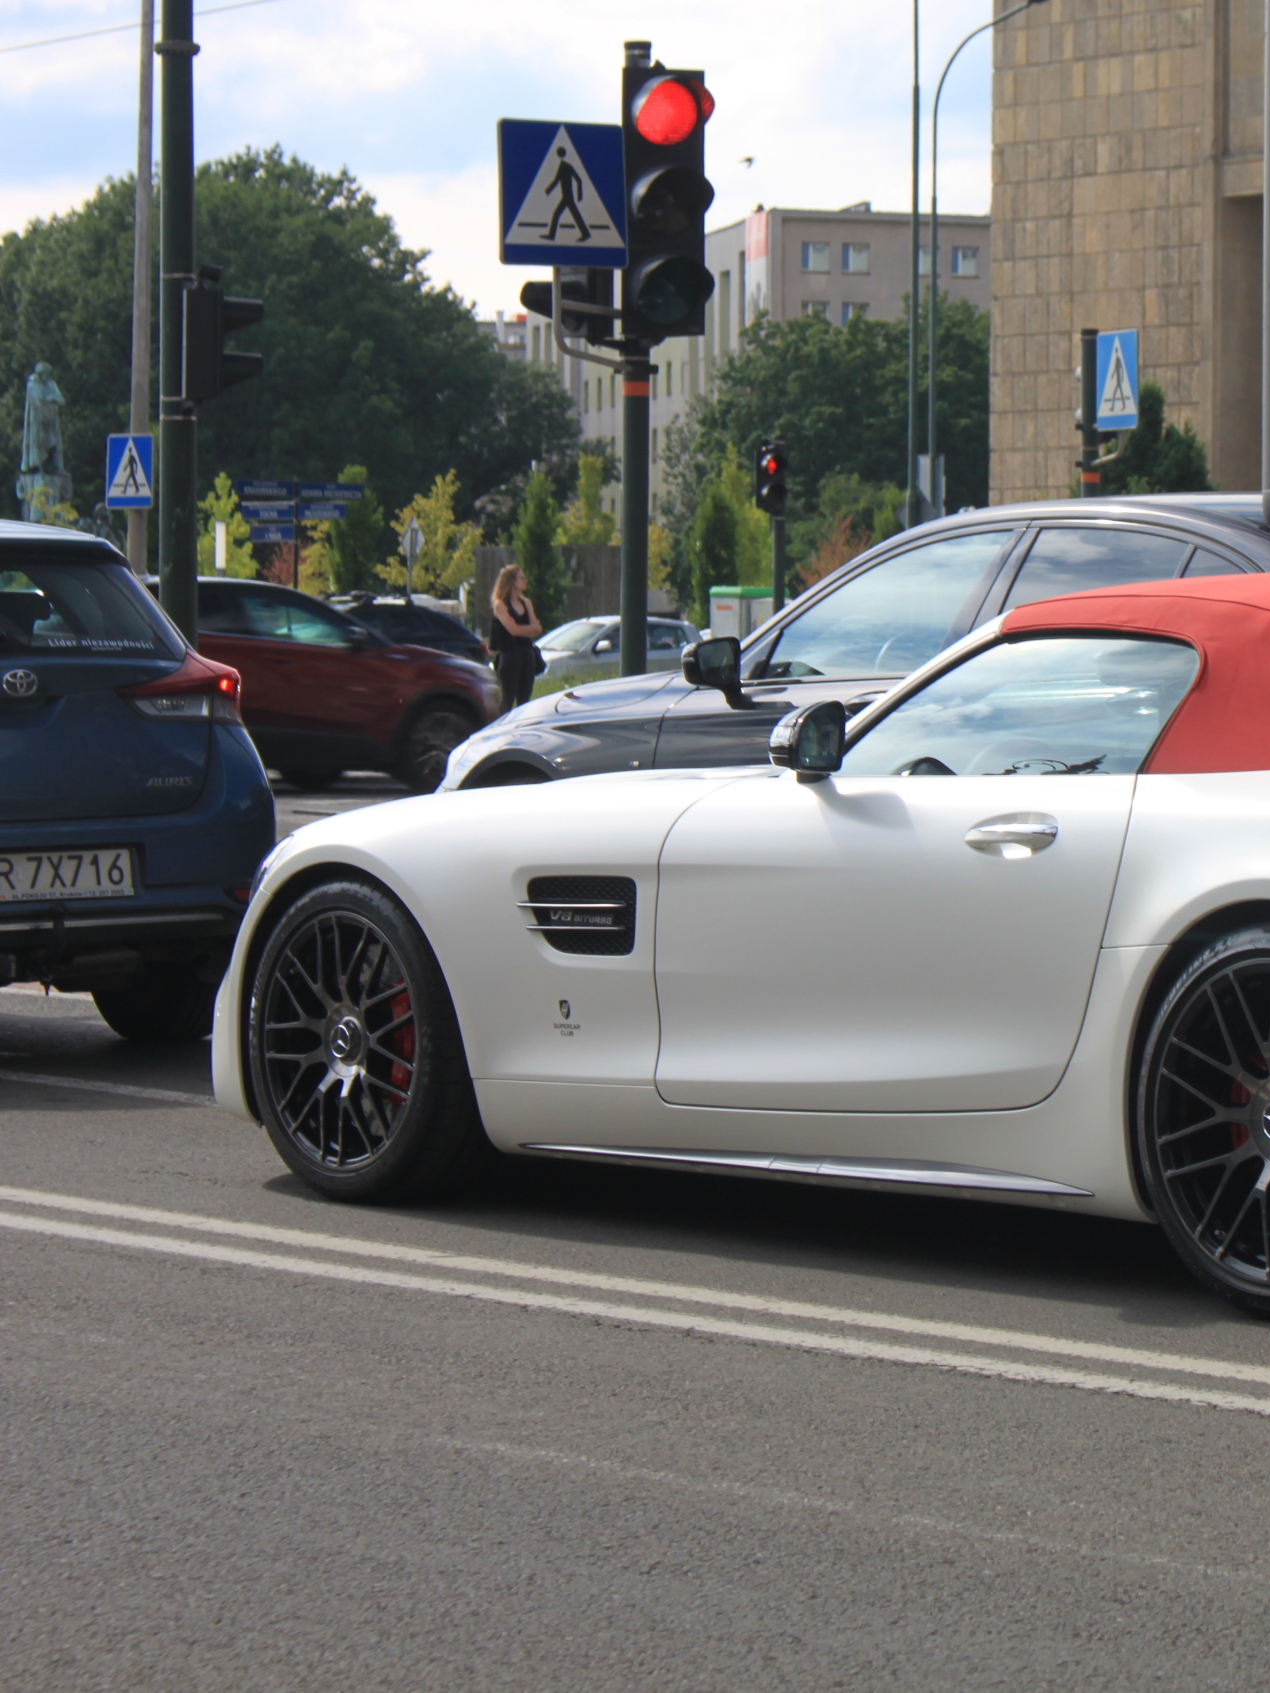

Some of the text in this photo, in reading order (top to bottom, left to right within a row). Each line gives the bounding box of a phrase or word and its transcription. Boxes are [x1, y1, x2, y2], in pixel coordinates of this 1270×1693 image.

[48, 639, 77, 647] Lider
[81, 639, 154, 650] niezawodności
[146, 776, 193, 787] AURIS
[26, 852, 124, 890] 7X716
[550, 909, 613, 925] V8 BITURBO
